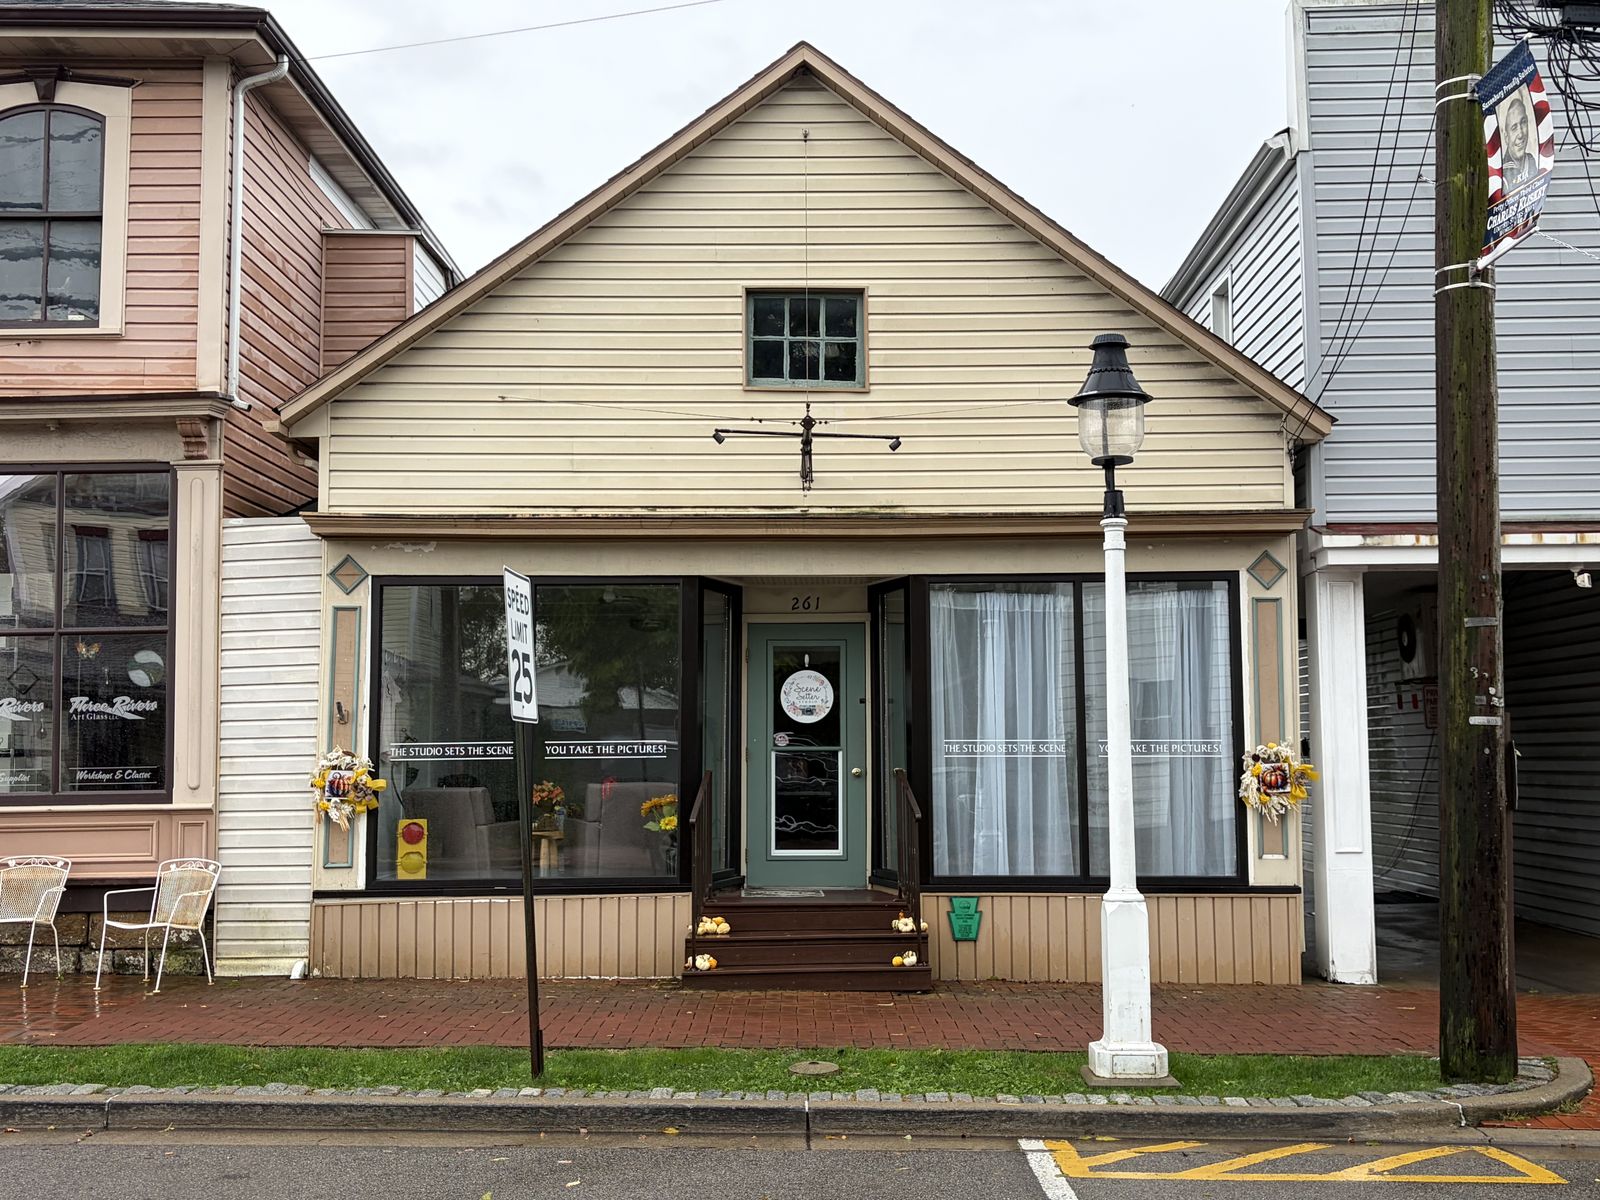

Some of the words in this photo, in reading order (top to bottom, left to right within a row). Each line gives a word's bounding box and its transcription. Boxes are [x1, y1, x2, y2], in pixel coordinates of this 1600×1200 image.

[1503, 77, 1520, 94] Proudly
[506, 587, 530, 615] SPEED
[791, 596, 820, 611] 261
[510, 618, 528, 645] LIMIT
[511, 649, 533, 704] 25
[794, 683, 821, 693] Scene
[796, 691, 820, 700] Setter
[69, 697, 109, 714] Three
[112, 695, 158, 715] Rivers
[389, 747, 407, 757] THE
[409, 747, 443, 756] STUDIO
[444, 746, 465, 756] SETS
[467, 746, 484, 755] THE
[486, 746, 514, 755] SCENE
[545, 745, 567, 754] YOU
[569, 745, 594, 754] TAKE
[596, 745, 615, 754] THE
[617, 744, 667, 754] PICTURES!
[944, 744, 961, 753] THE
[962, 744, 996, 753] STUDIO
[997, 744, 1018, 753] SETS
[1020, 744, 1037, 753] THE
[1038, 744, 1066, 753] SCENE
[1150, 744, 1169, 753] THE
[1171, 744, 1222, 753] PICTURES!
[76, 770, 113, 782] Workshops
[114, 769, 123, 779] &
[124, 769, 152, 780] Classes
